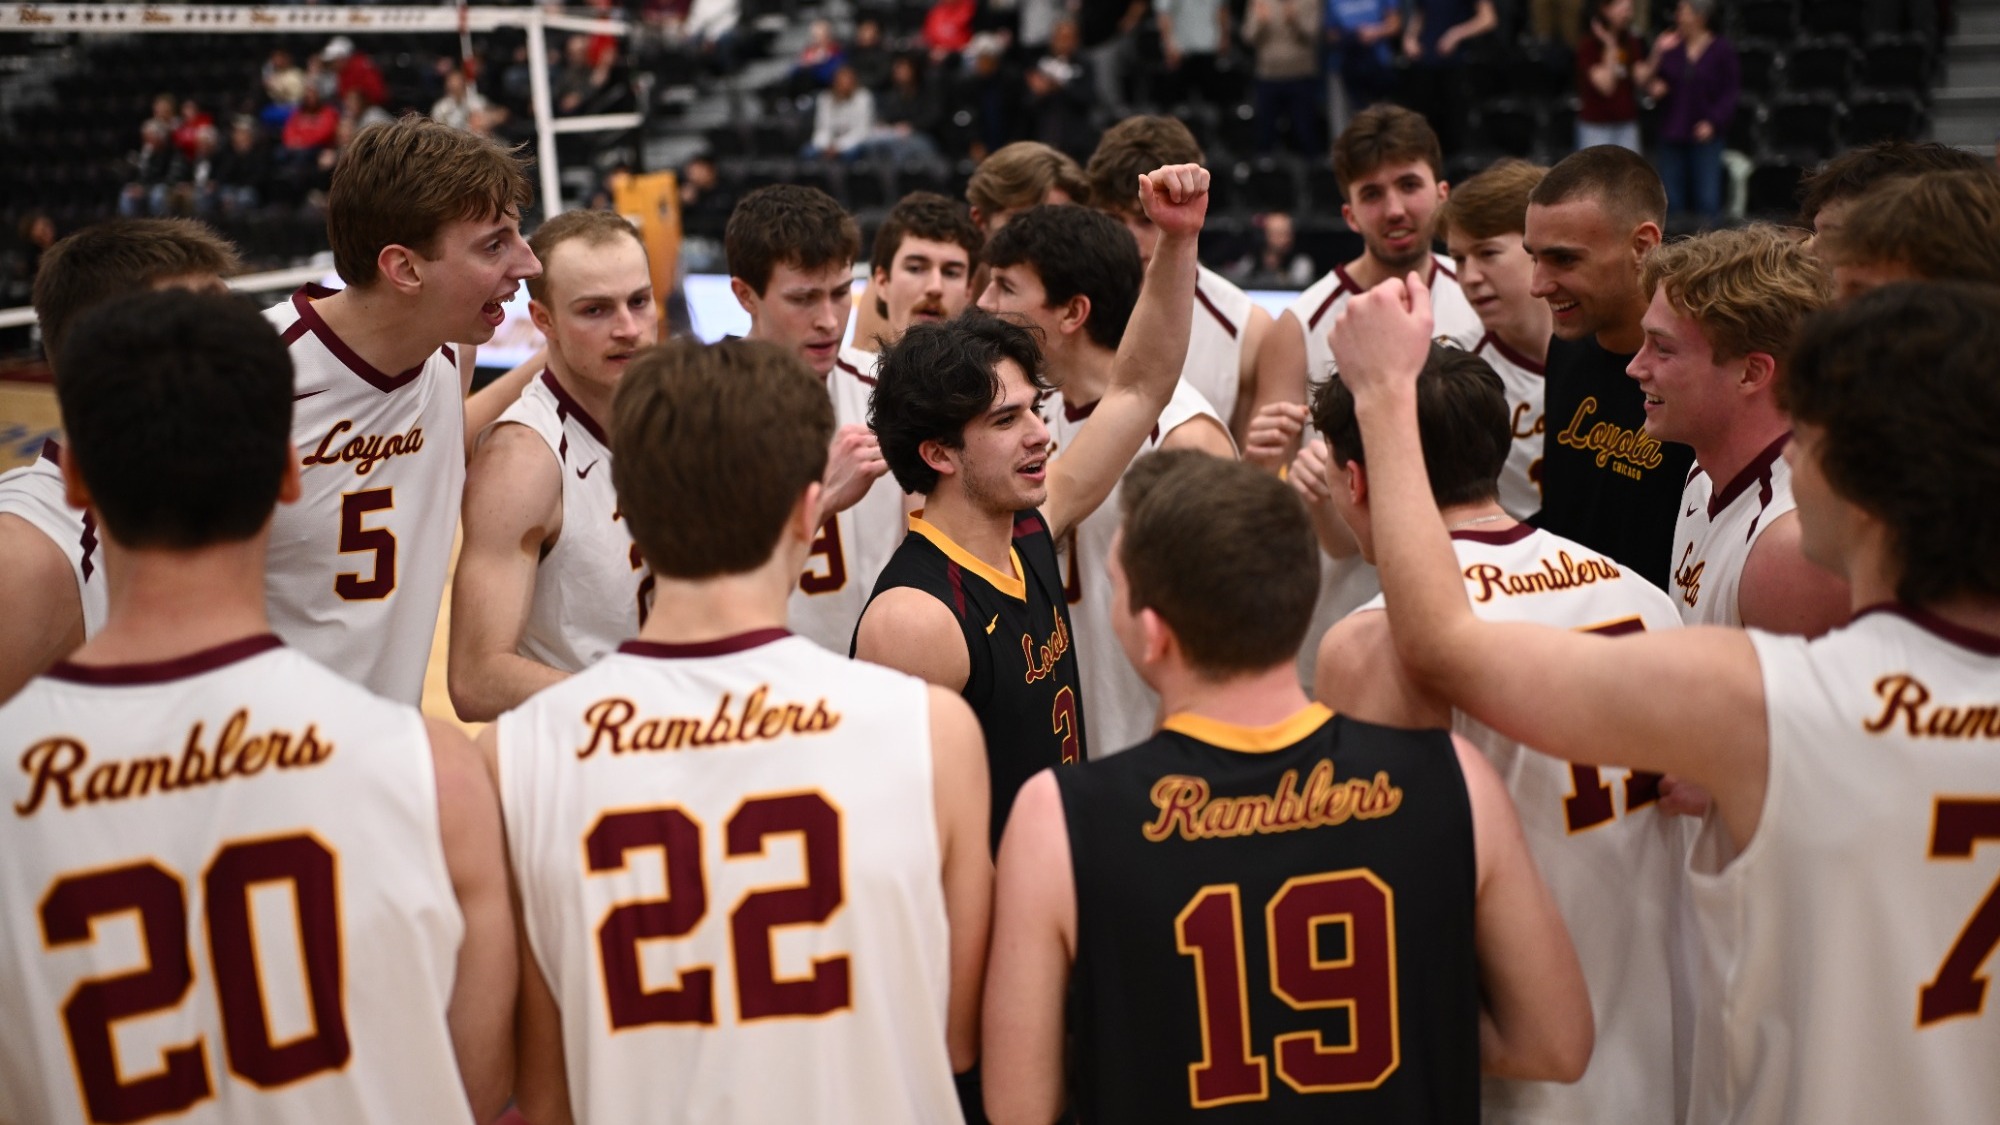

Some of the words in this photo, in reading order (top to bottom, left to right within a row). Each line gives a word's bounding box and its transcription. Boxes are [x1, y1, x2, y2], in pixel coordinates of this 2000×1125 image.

[302, 419, 424, 476] Loyoa
[1558, 396, 1664, 469] Loyola
[1612, 460, 1642, 481] CHICAGO
[333, 485, 398, 603] 5
[1464, 550, 1621, 602] Ramblers
[14, 707, 334, 817] Ramblers
[576, 683, 842, 762] Ramblers
[1142, 757, 1403, 842] Ramblers
[582, 787, 855, 1036] 22
[1915, 794, 2000, 1032] 7
[36, 826, 352, 1125] 20
[1174, 867, 1400, 1109] 19
